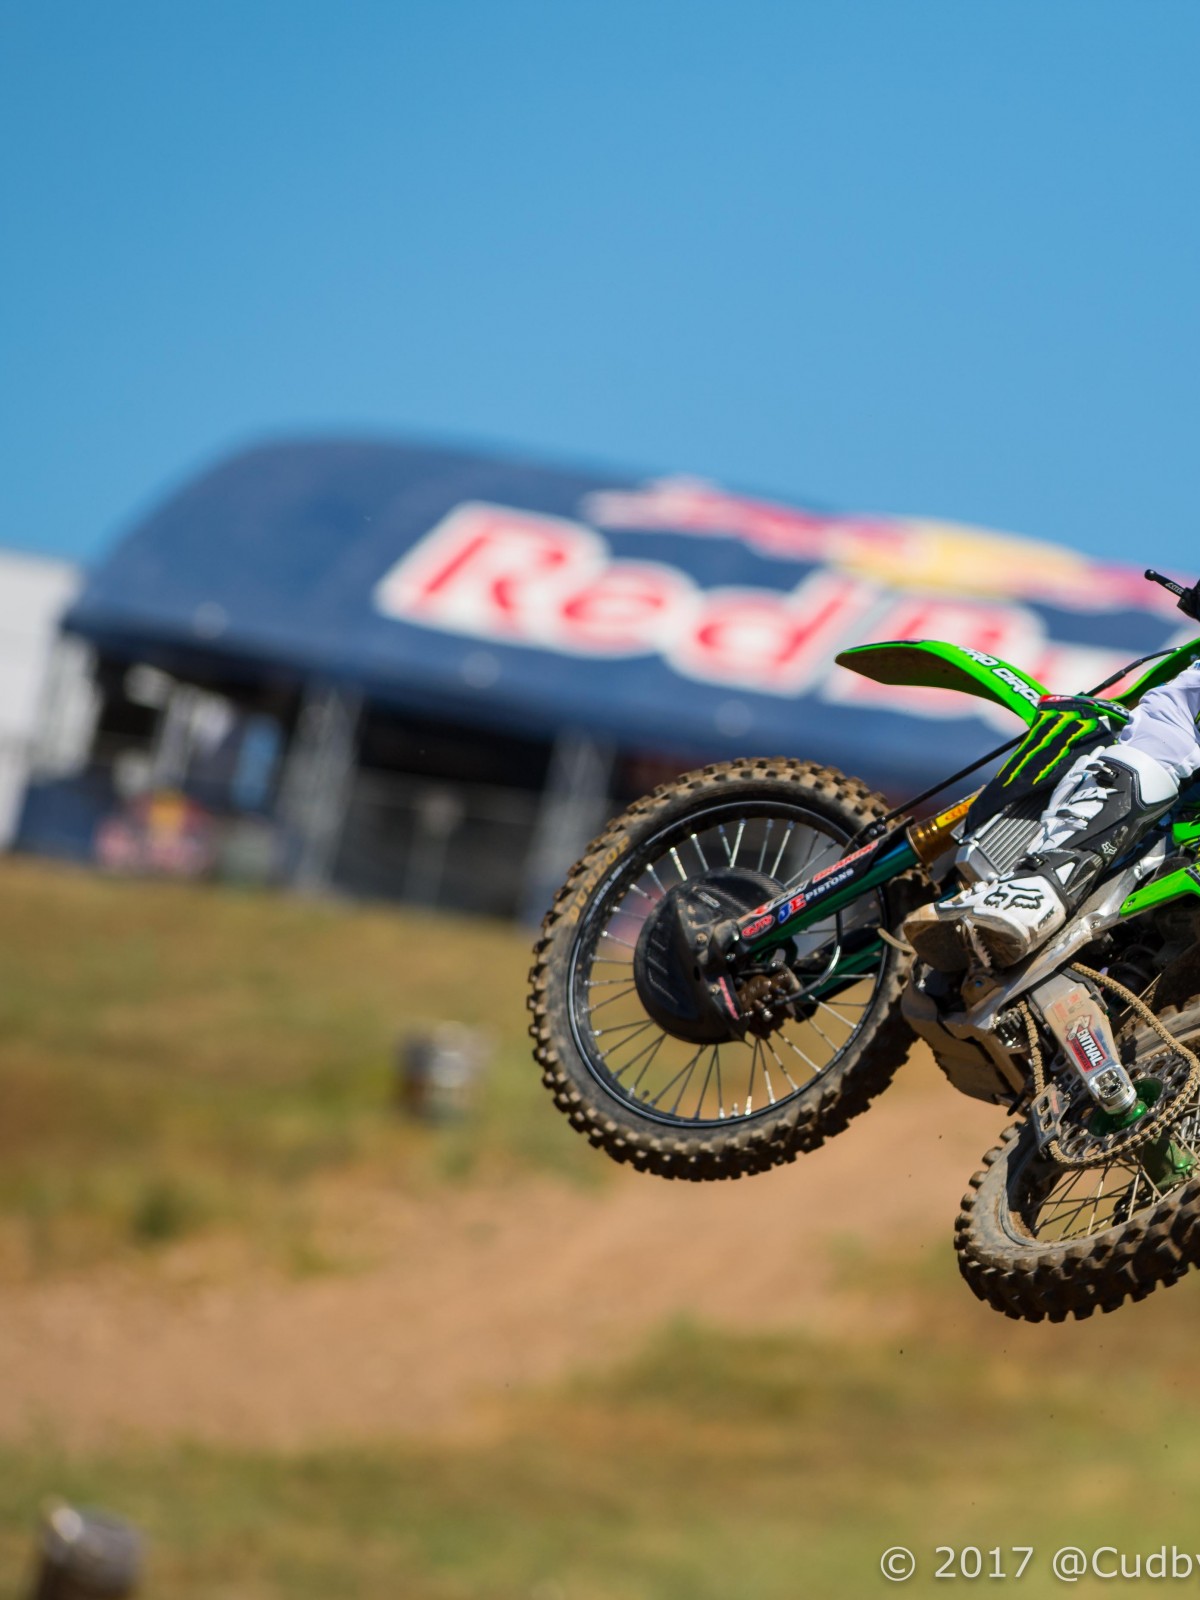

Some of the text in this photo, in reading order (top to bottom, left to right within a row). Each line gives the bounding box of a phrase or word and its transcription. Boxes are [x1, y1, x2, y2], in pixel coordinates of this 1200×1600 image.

[991, 667, 1041, 708] CIRC
[777, 893, 807, 924] JE
[804, 867, 855, 901] PISTONS
